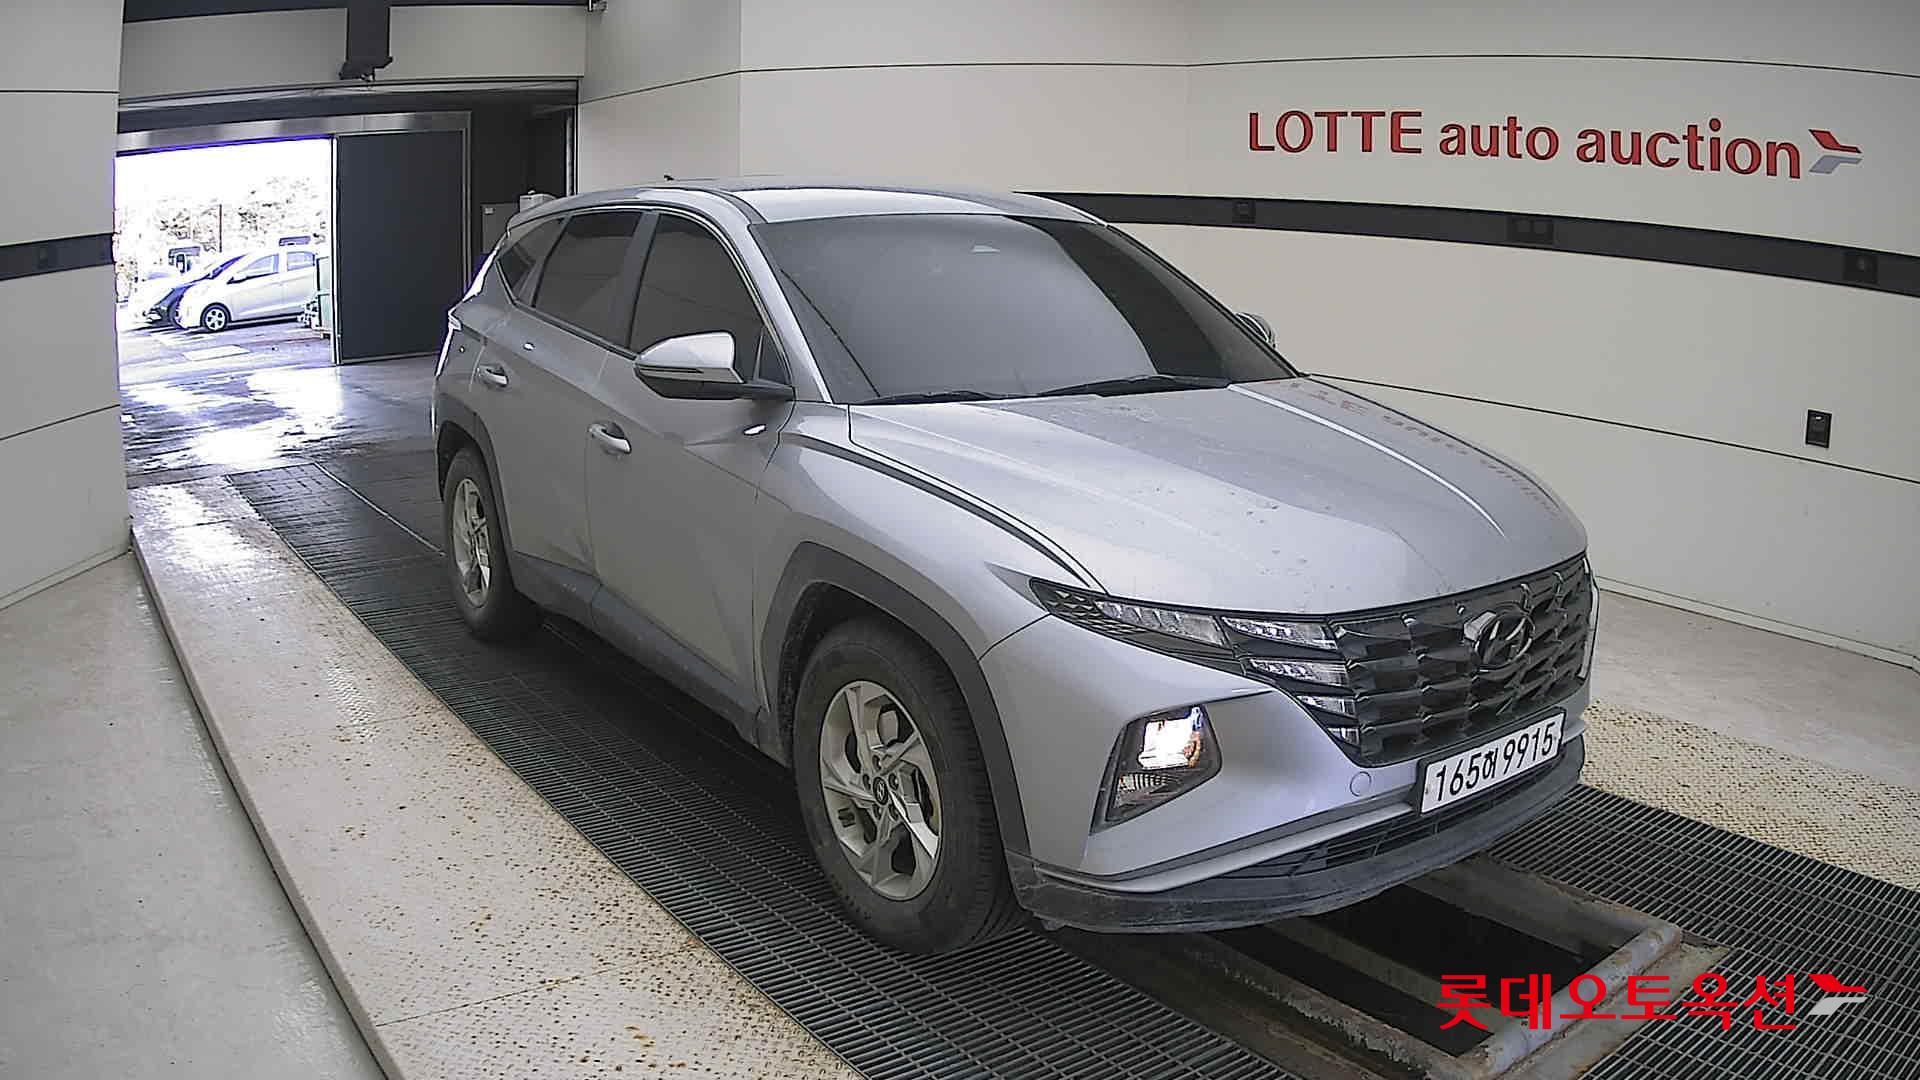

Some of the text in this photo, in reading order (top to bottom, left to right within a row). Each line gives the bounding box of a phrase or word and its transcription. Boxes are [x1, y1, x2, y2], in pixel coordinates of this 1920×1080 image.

[1248, 110, 1802, 180] LOTTE auto auction
